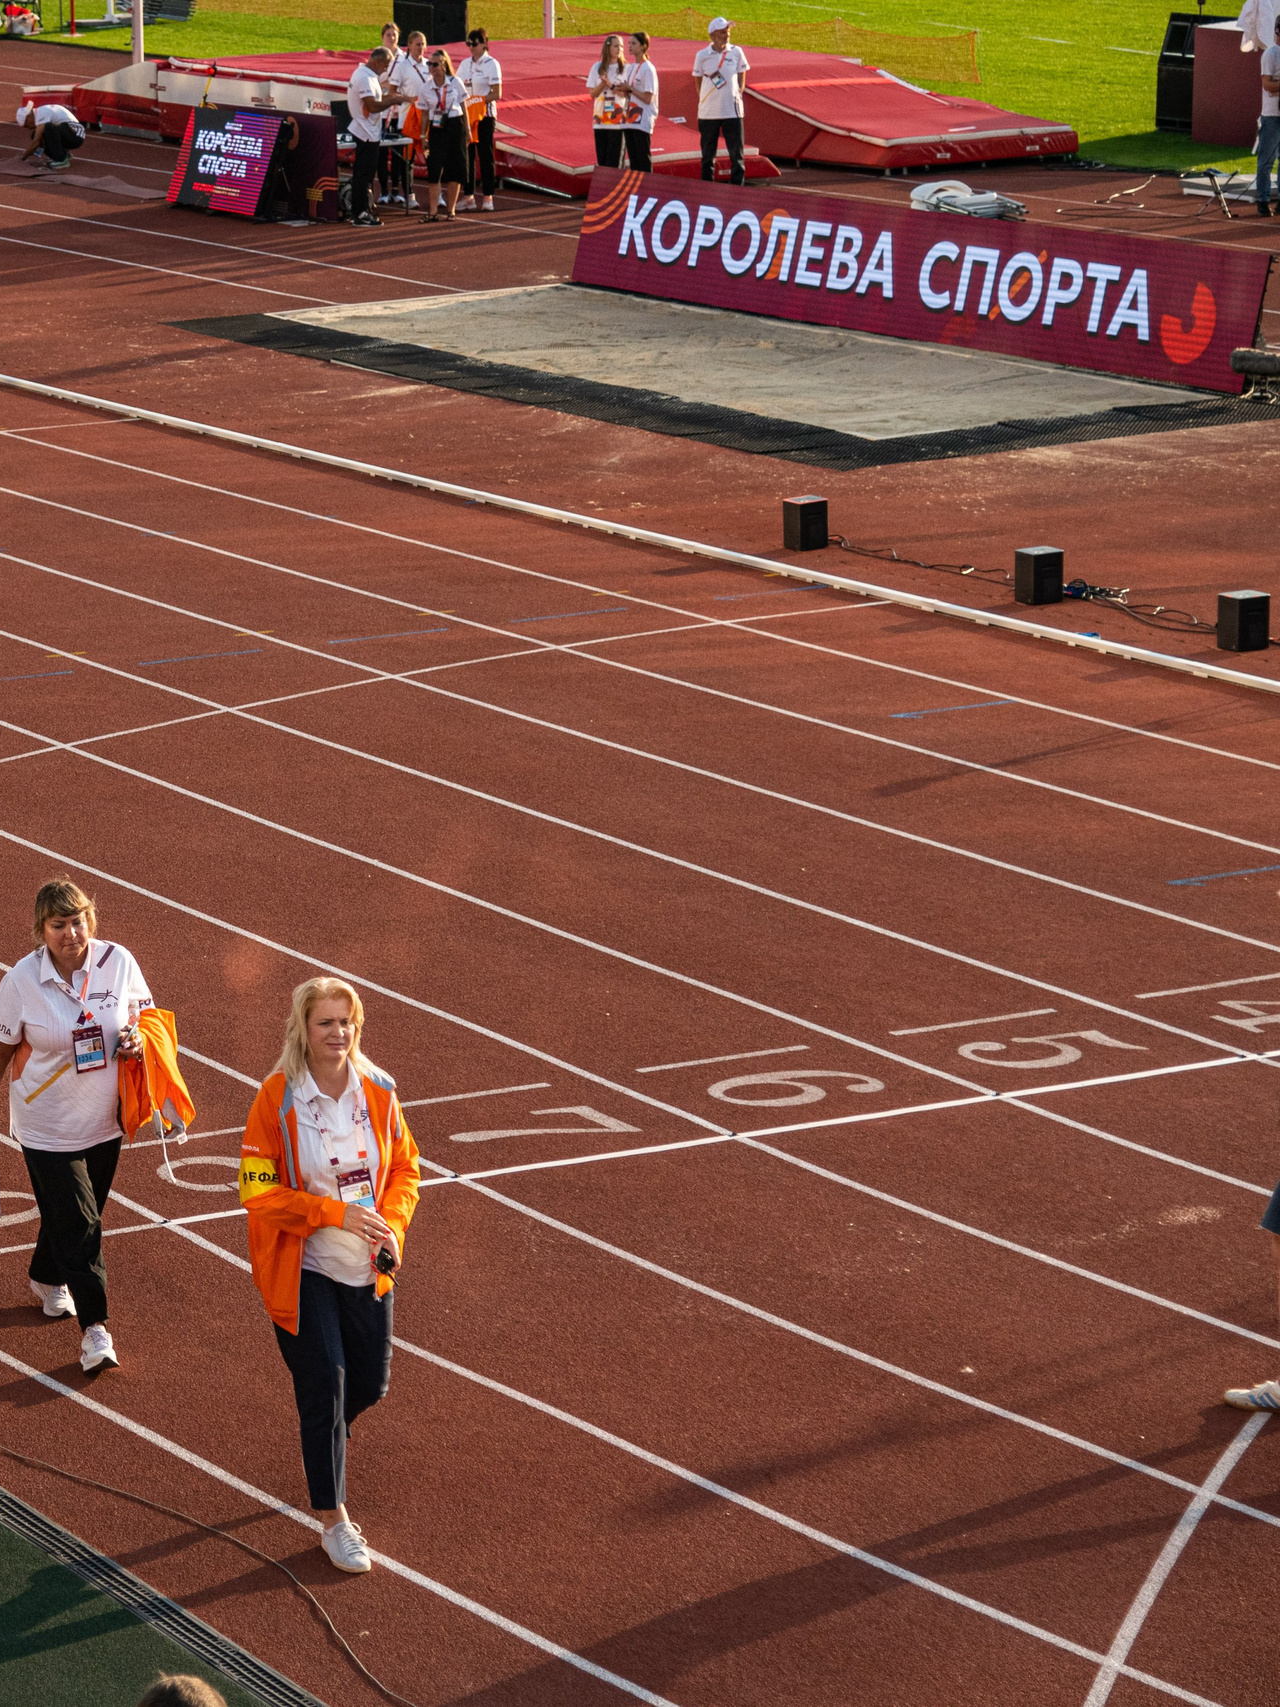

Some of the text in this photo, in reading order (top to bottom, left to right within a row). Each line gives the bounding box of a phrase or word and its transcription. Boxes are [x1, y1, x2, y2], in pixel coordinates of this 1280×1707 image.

[195, 129, 263, 158] КОРОЛЕВА
[197, 154, 248, 178] СПОРТА
[618, 194, 1151, 342] КОРОЛЕВА СПОРТА
[99, 1002, 119, 1011] ВФЛ
[958, 1028, 1150, 1069] 5
[707, 1069, 886, 1107] 6
[448, 1104, 643, 1143] 7
